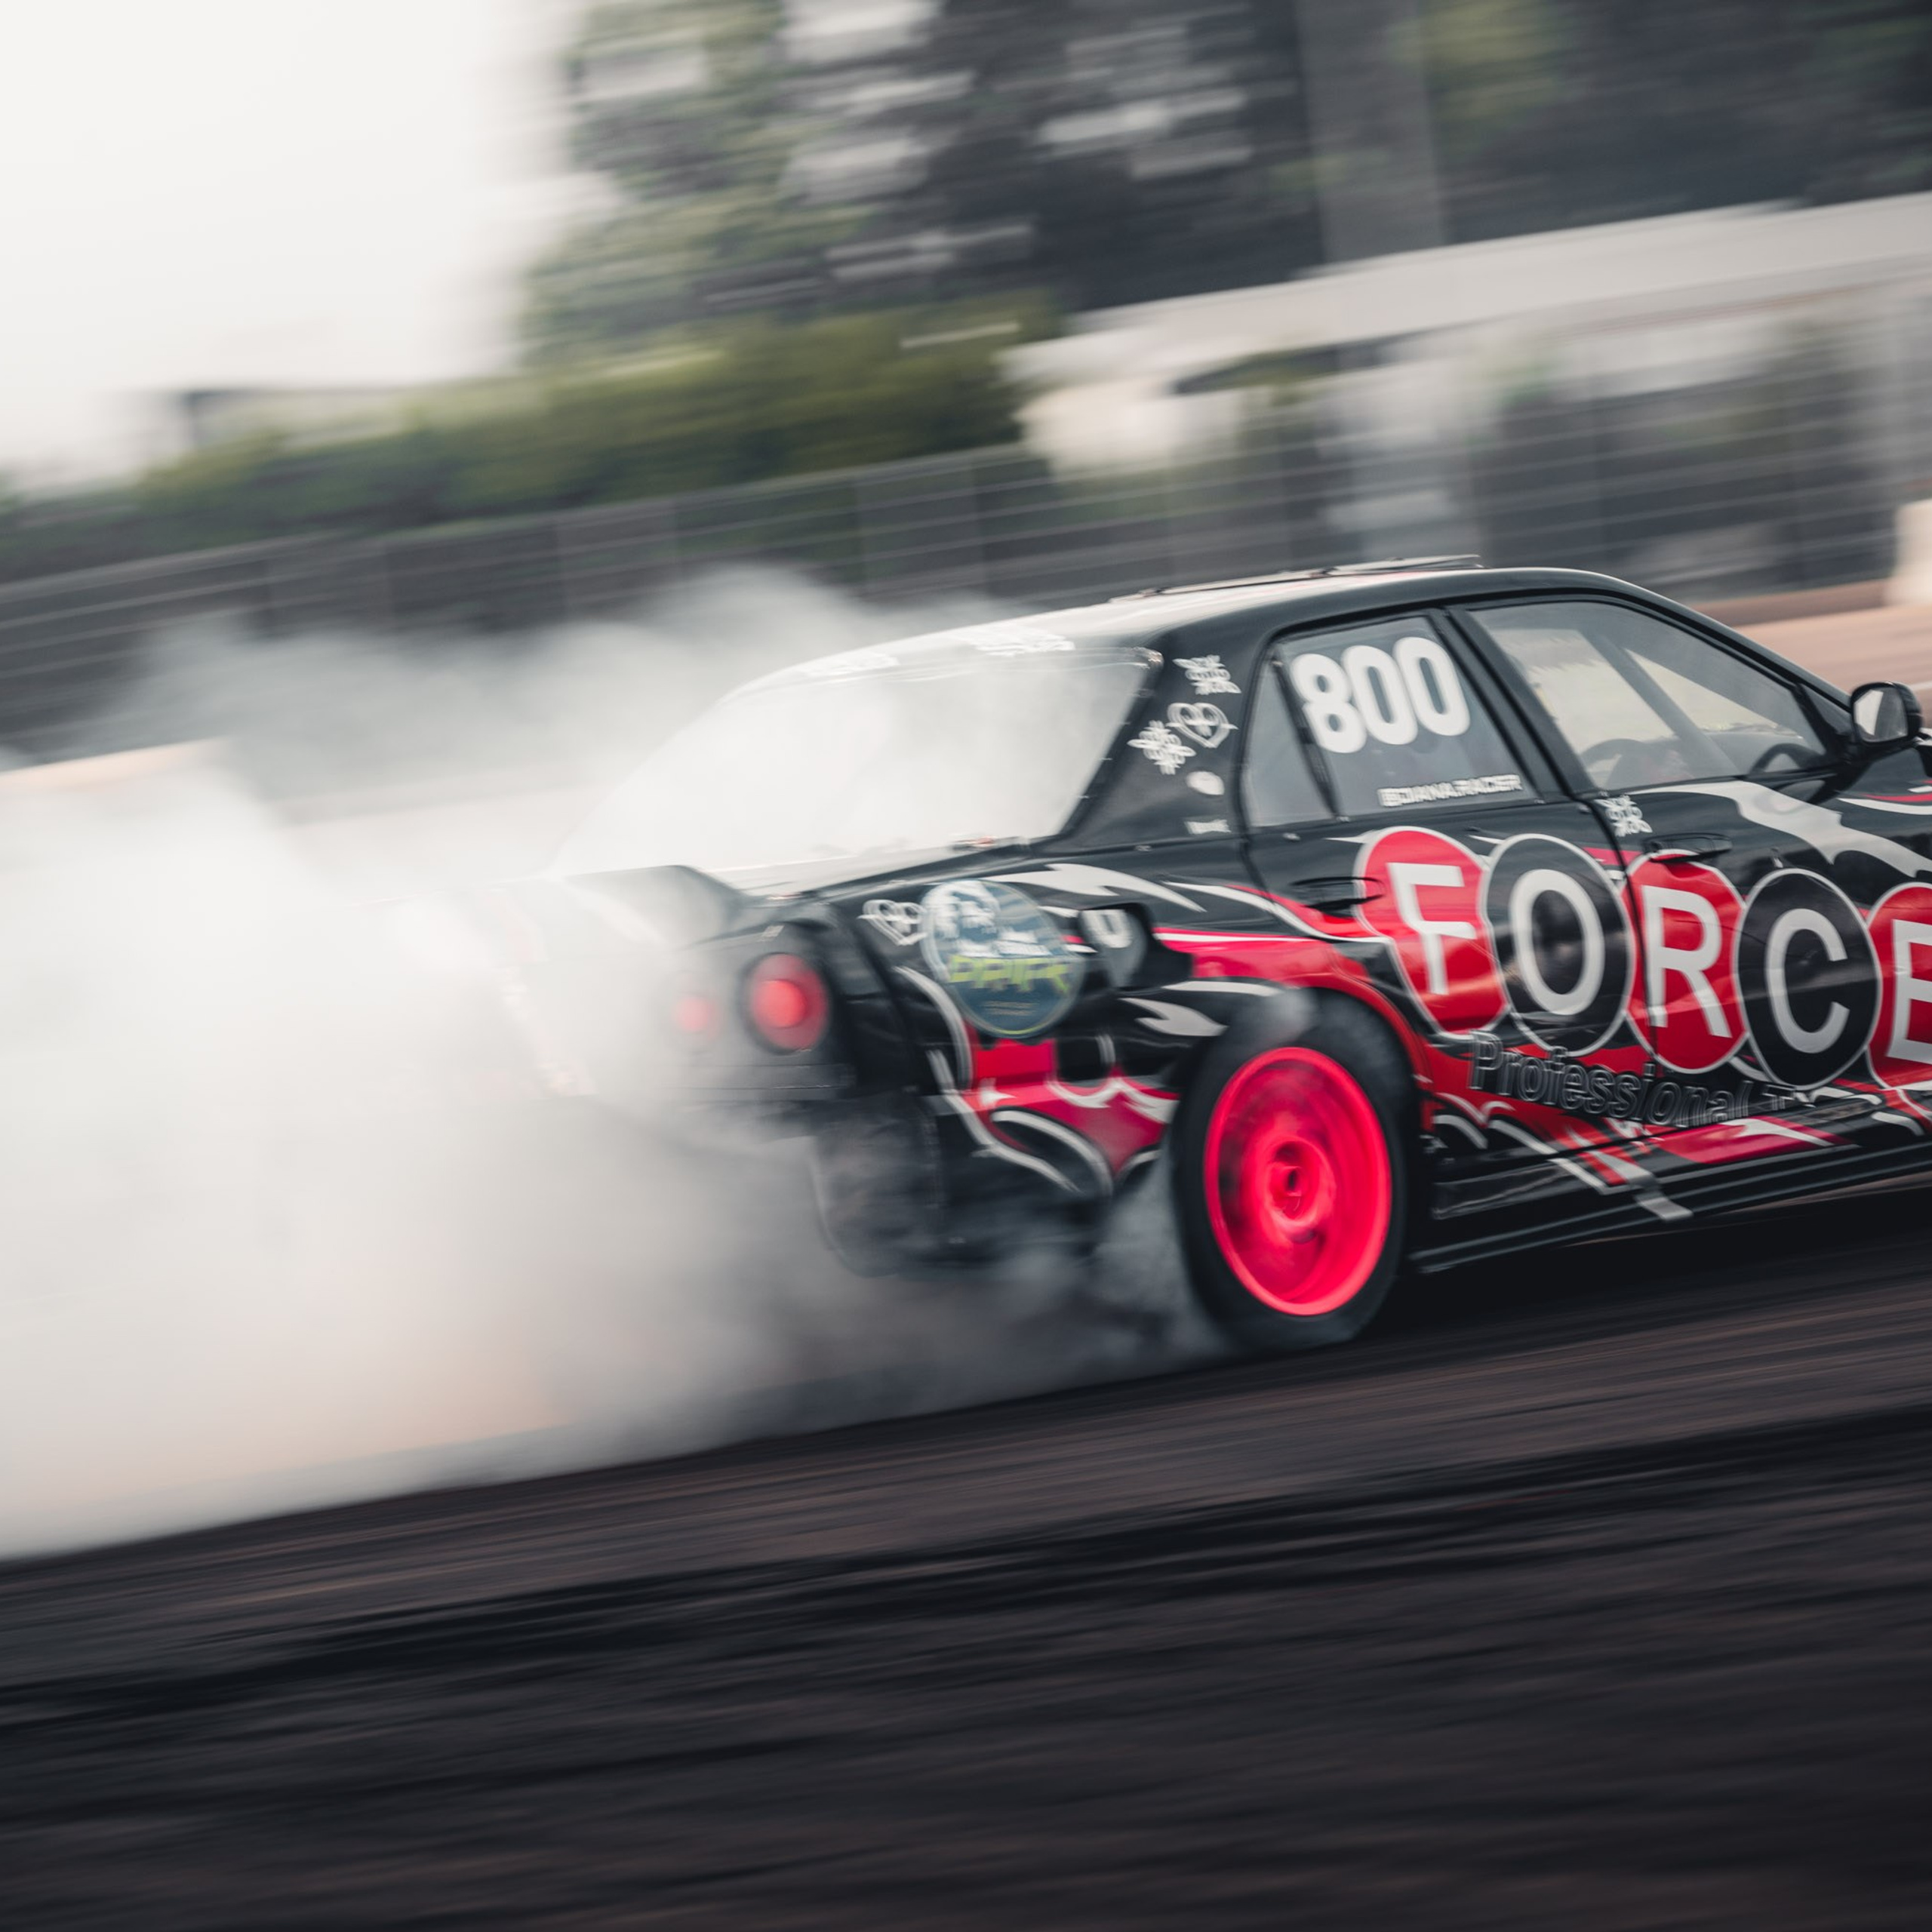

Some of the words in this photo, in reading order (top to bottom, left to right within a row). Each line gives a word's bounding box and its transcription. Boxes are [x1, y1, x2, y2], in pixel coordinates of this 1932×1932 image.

[1290, 636, 1471, 753] 800
[1389, 862, 1932, 1066] FORCE
[1467, 1029, 1752, 1128] Professional
